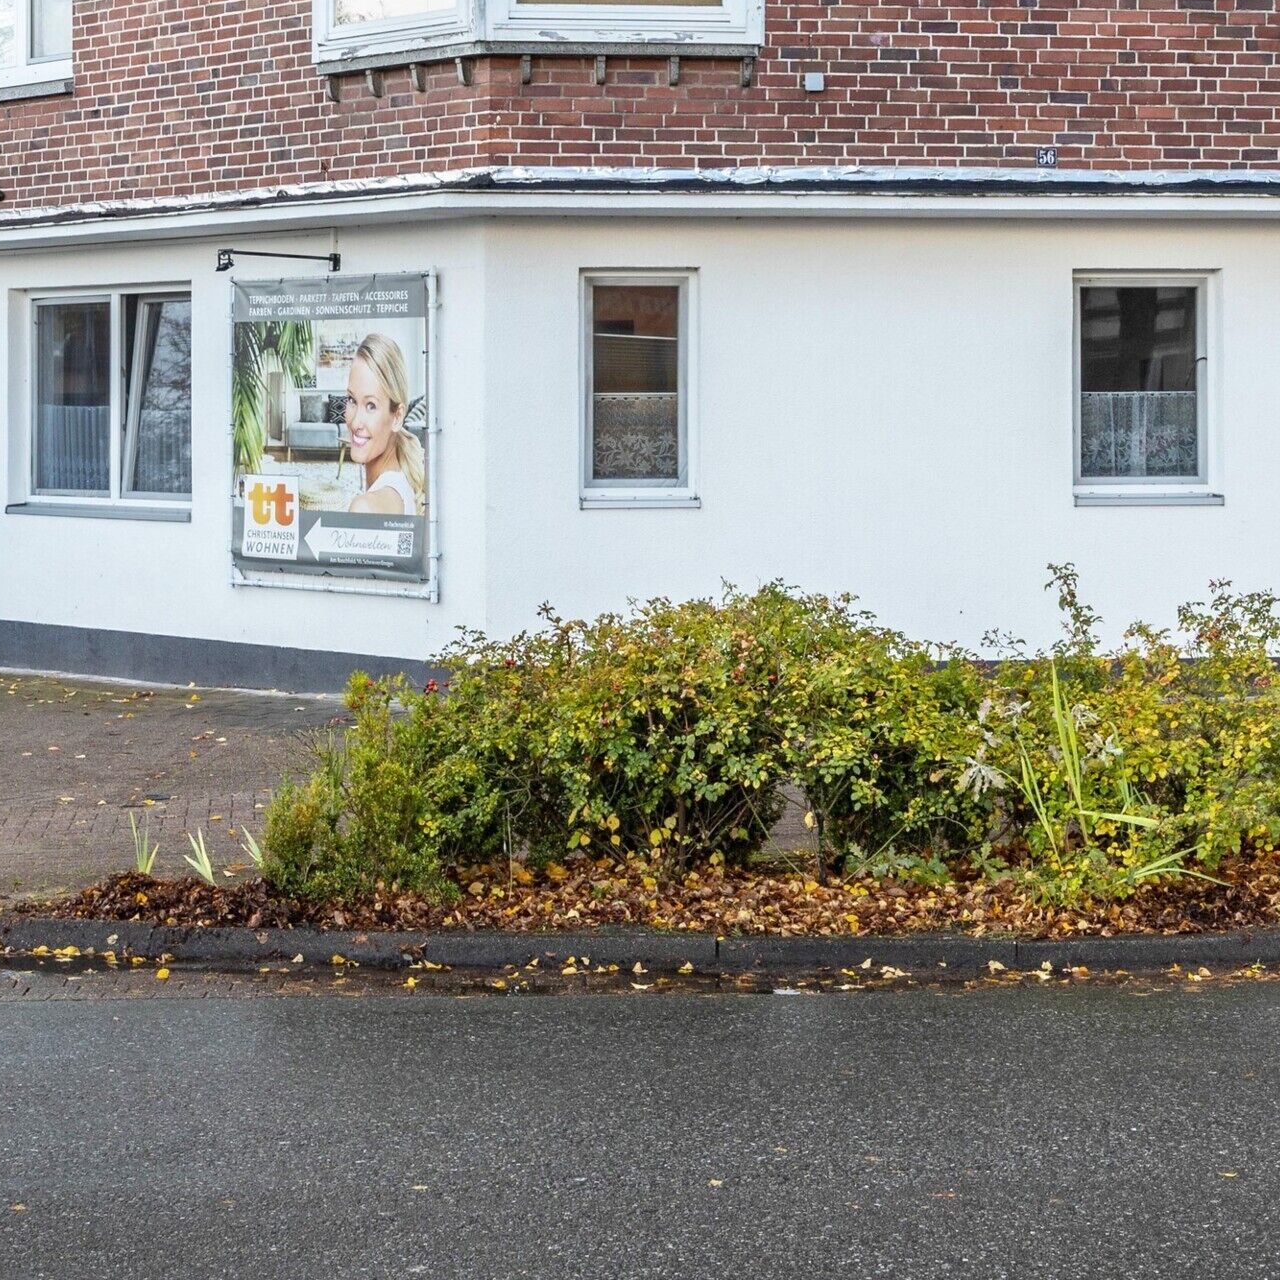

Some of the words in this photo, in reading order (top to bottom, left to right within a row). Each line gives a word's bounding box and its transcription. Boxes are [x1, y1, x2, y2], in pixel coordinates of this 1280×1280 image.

[1039, 150, 1055, 164] 56
[249, 295, 295, 305] TEPPICHBODEN
[299, 294, 327, 304] PARKETT
[331, 292, 359, 303] TAPETEN
[365, 290, 408, 301] ACCESSOIRES
[249, 307, 272, 317] FARBEN
[277, 306, 310, 316] GARDINEN
[315, 304, 371, 315] SONNENSCHUTZ
[376, 303, 409, 313] TEPPICHE
[248, 483, 294, 526] tt
[247, 530, 295, 541] CHRISTIANSEN
[246, 541, 294, 555] WOHNEN
